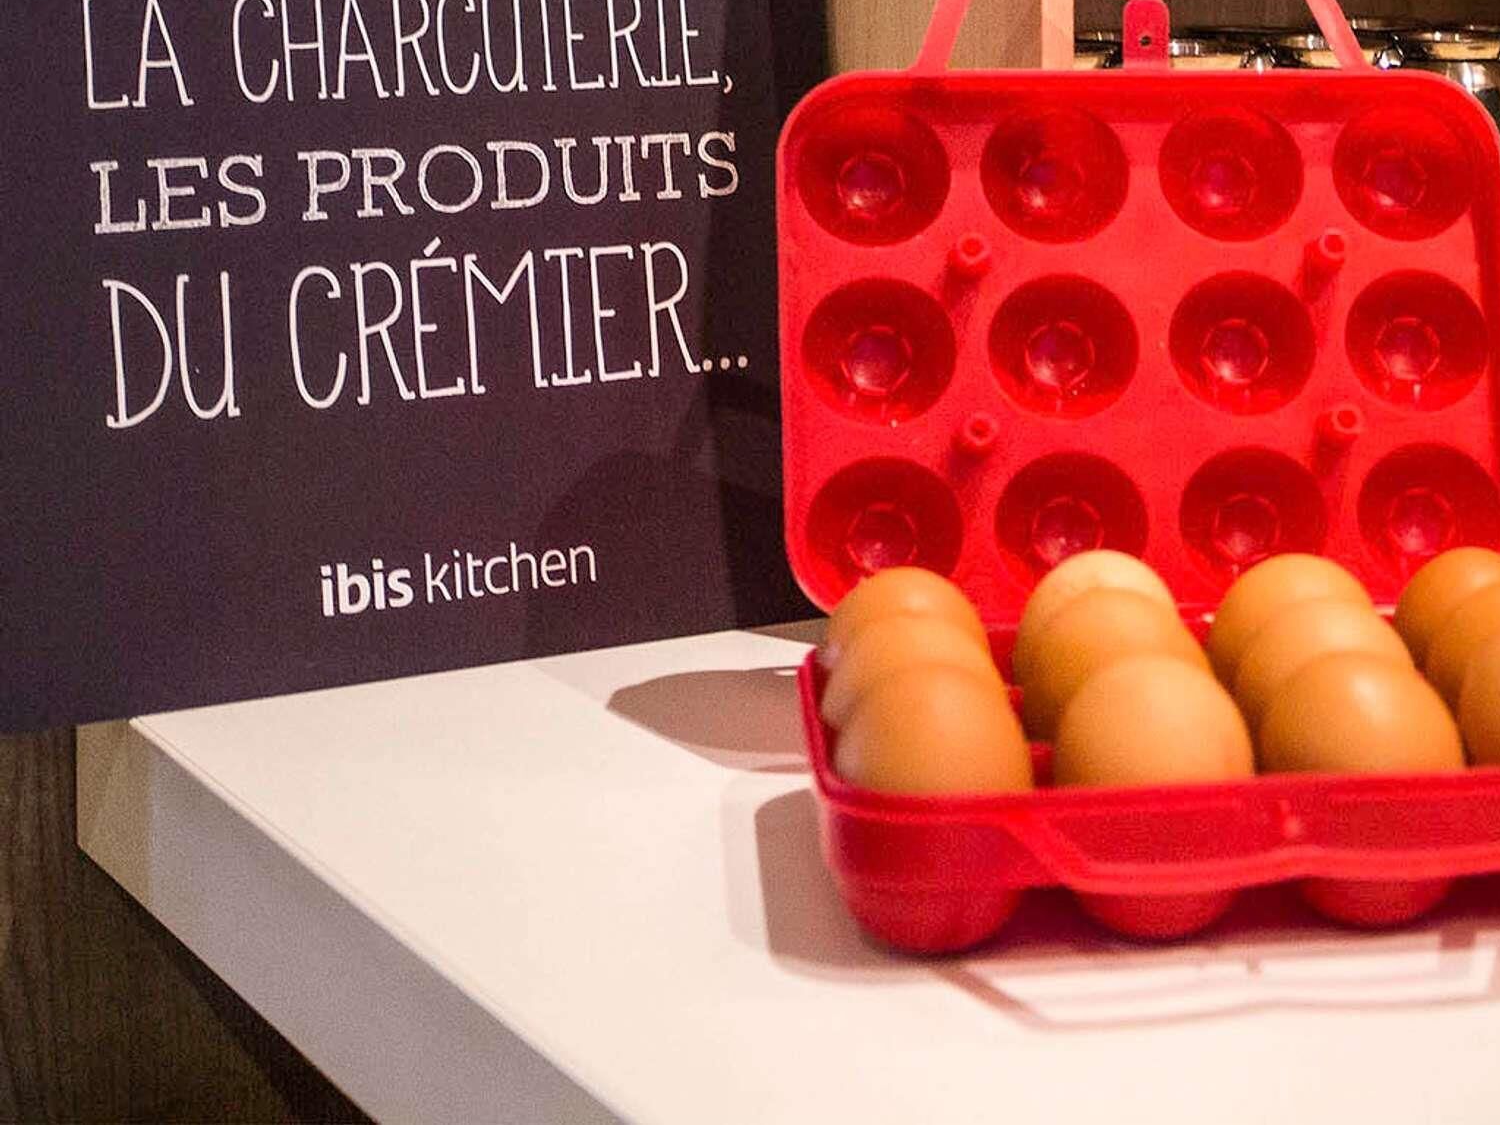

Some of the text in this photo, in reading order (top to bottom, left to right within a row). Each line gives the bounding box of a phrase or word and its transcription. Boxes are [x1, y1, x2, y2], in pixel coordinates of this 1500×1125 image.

[90, 131, 738, 234] LES PRODUITS
[103, 237, 747, 428] DU CRÉMIER...
[321, 542, 596, 616] ibis kitchen
